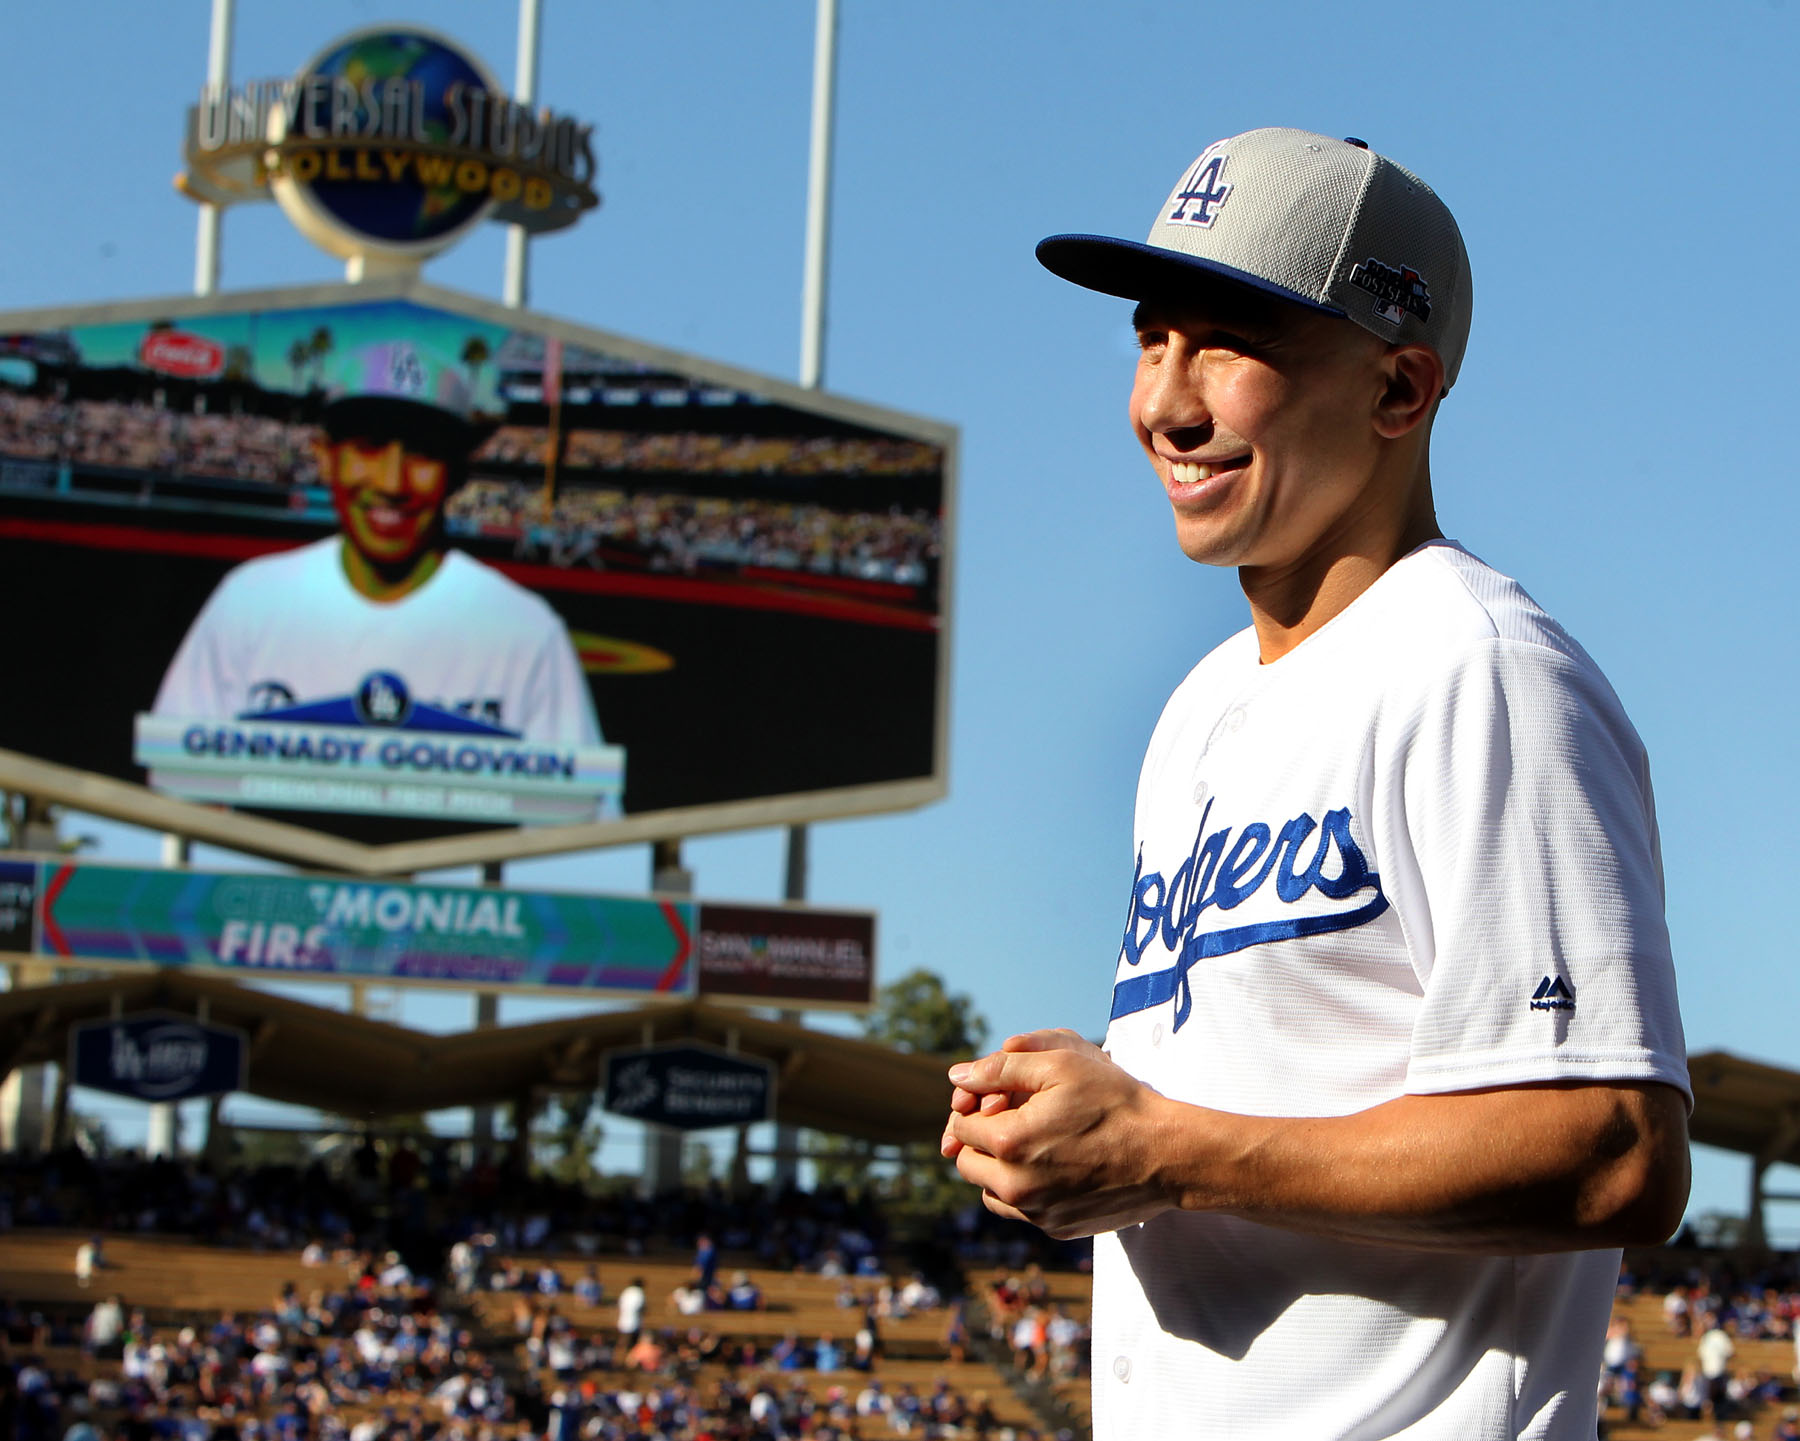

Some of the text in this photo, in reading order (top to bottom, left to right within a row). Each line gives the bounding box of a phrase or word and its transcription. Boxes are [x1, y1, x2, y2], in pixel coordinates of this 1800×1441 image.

[201, 74, 595, 186] UNIVERSAL STUDIOS
[1166, 138, 1232, 228] LA
[183, 725, 577, 778] GENNADY GOLOVKIN
